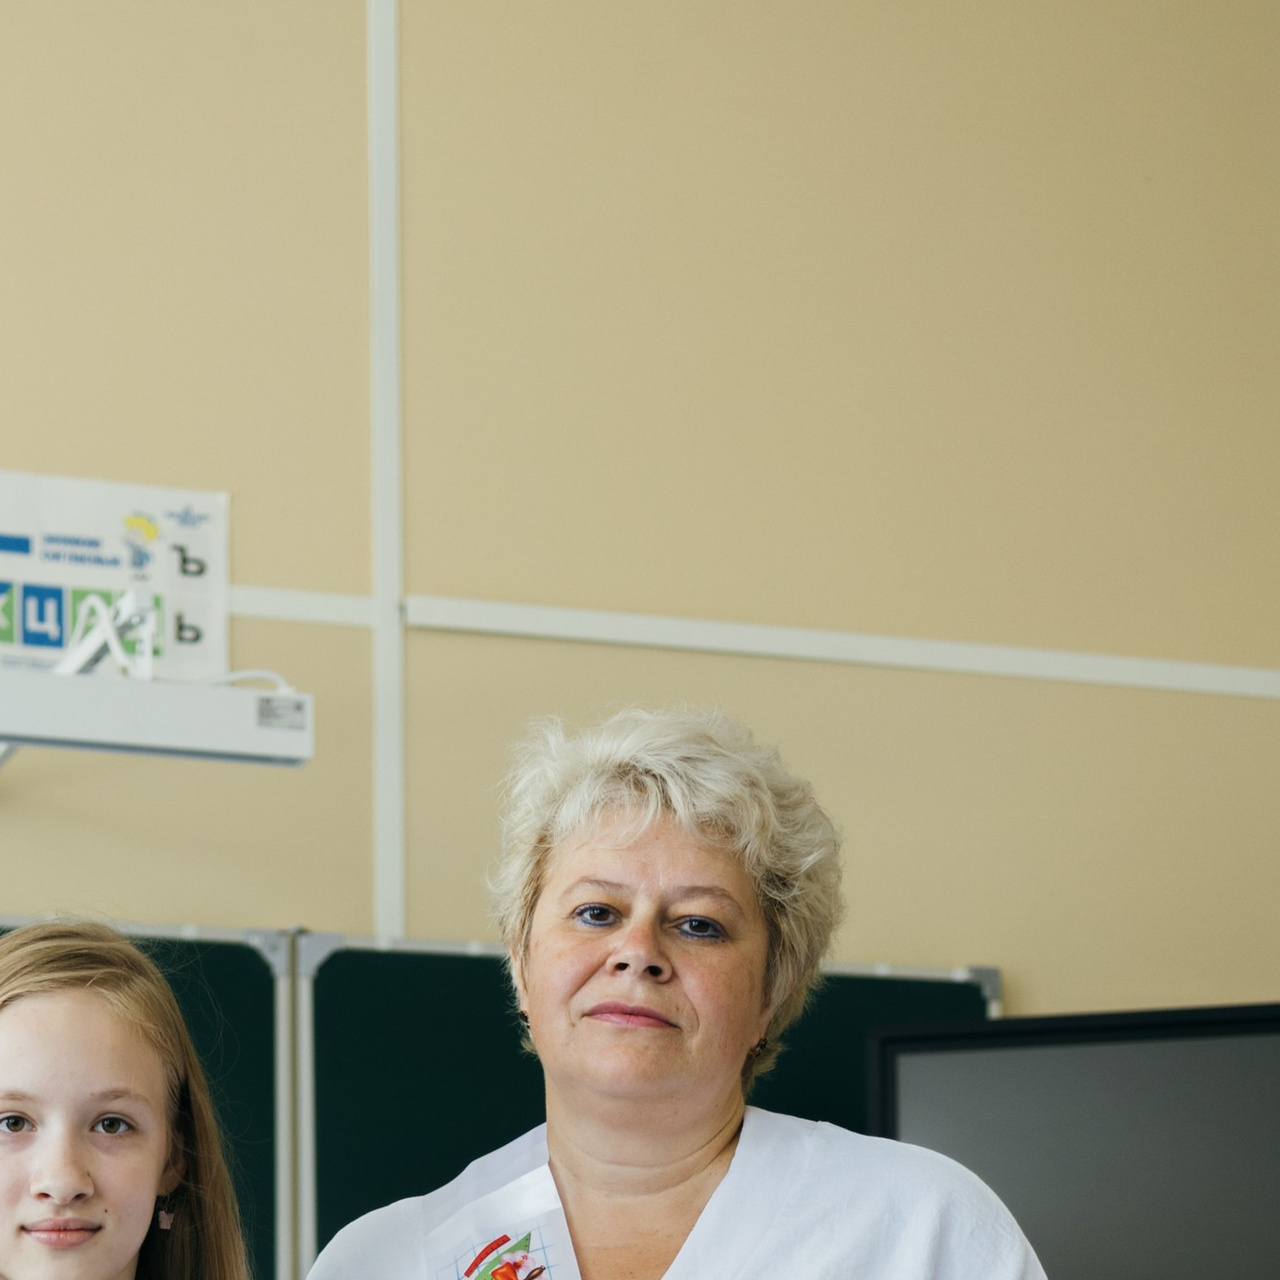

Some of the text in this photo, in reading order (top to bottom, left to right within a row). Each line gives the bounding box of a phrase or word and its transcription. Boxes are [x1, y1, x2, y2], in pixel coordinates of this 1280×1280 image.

[172, 542, 207, 577] Ъ
[23, 596, 61, 641] Ц
[175, 612, 203, 645] Ь
